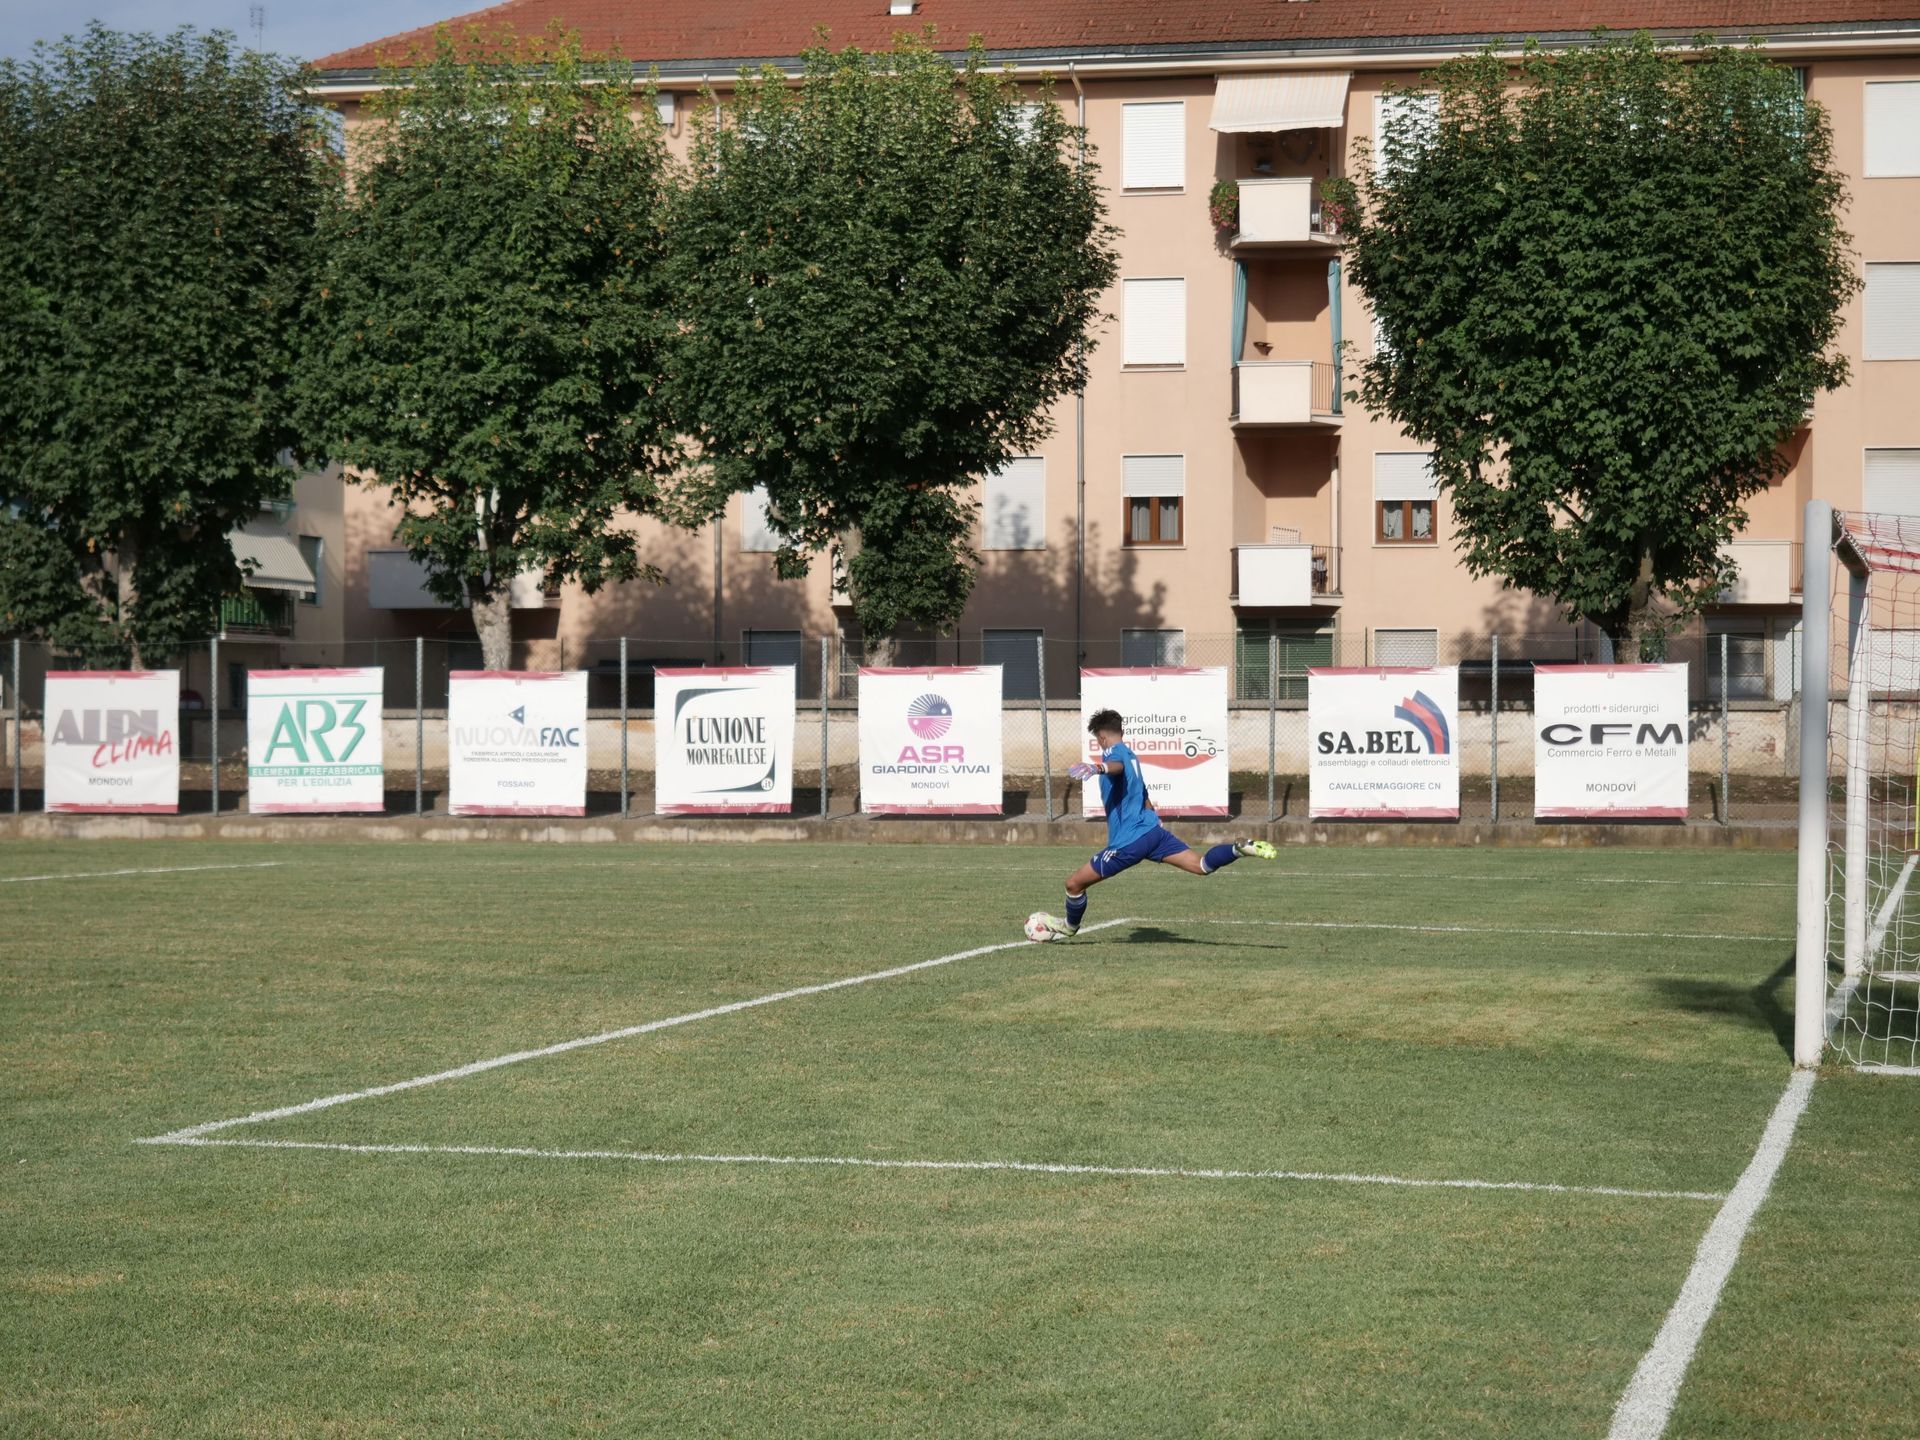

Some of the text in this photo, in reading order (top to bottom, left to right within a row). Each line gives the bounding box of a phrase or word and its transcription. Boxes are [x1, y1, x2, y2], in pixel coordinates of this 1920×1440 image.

[1563, 703, 1660, 715] prodotti siderurgici
[1122, 714, 1187, 725] gricoltura e
[51, 709, 159, 746] ALPI
[263, 700, 368, 764] AR3
[685, 716, 766, 744] L'UNIONE
[1122, 726, 1186, 737] iardinaggio
[1540, 723, 1684, 746] CFM
[1089, 738, 1182, 752] Bioanni
[1317, 730, 1421, 755] SA.BEL
[92, 730, 172, 768] CLIMA
[897, 745, 965, 764] ASR
[1547, 748, 1603, 758] Commercio
[1606, 748, 1633, 757] Ferro
[1644, 748, 1677, 757] Metalli
[686, 747, 767, 765] MONREGALESE
[1318, 758, 1369, 768] assemblaggi
[1378, 758, 1409, 767] collaudi
[1411, 758, 1451, 767] elettronici
[252, 766, 380, 776] ELEMENTI PREFABBRICATI
[872, 765, 990, 774] GIARDINI & VIVAI
[277, 777, 352, 787] PER L'EDILIZIA
[1147, 783, 1172, 791] ANFEI
[1329, 782, 1441, 791] CAVALLERMAGGIORE CN
